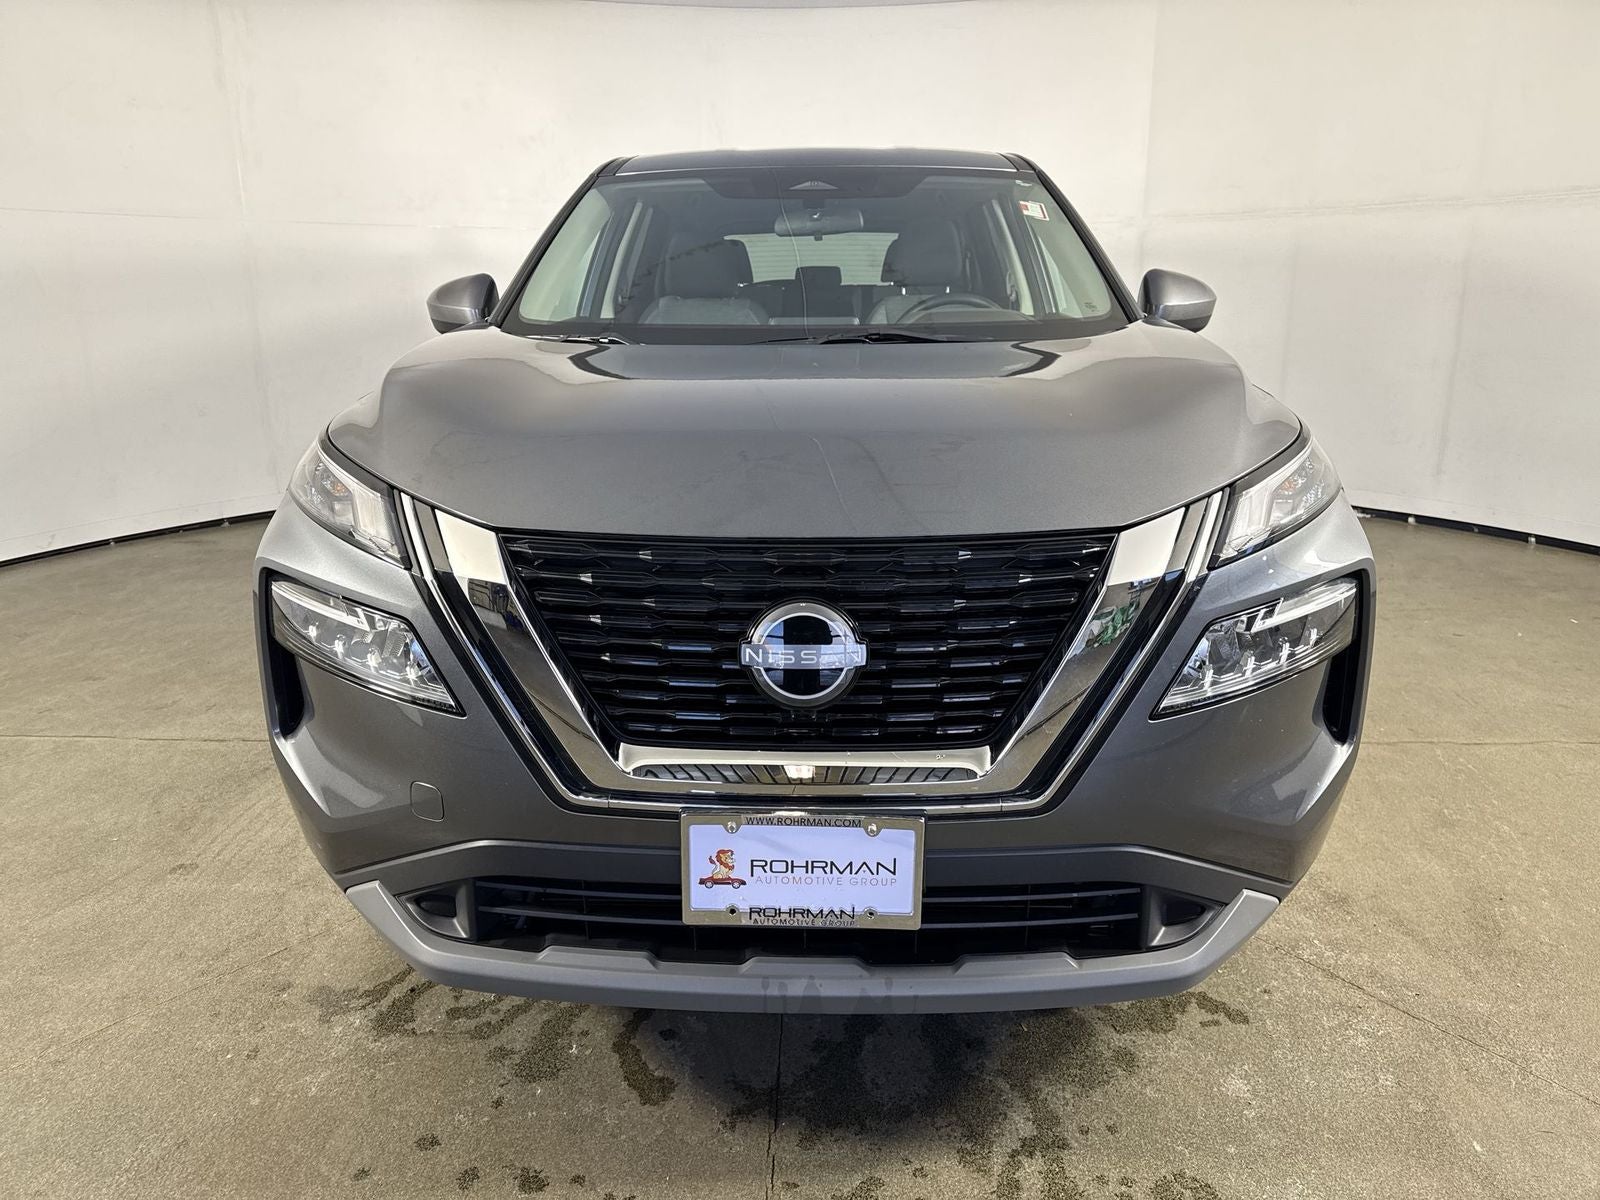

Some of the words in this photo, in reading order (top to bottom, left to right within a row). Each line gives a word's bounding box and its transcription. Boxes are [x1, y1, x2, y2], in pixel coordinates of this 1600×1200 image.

[745, 816, 862, 828] WWW.ROHRMAN.COM
[750, 858, 897, 877] ROHRMAN
[755, 876, 843, 886] AUTOMOTIVE
[849, 877, 897, 888] GROUP
[749, 906, 855, 920] ROHRMAN
[753, 918, 816, 926] AUTOMOTIVE
[821, 919, 855, 927] GROUP
